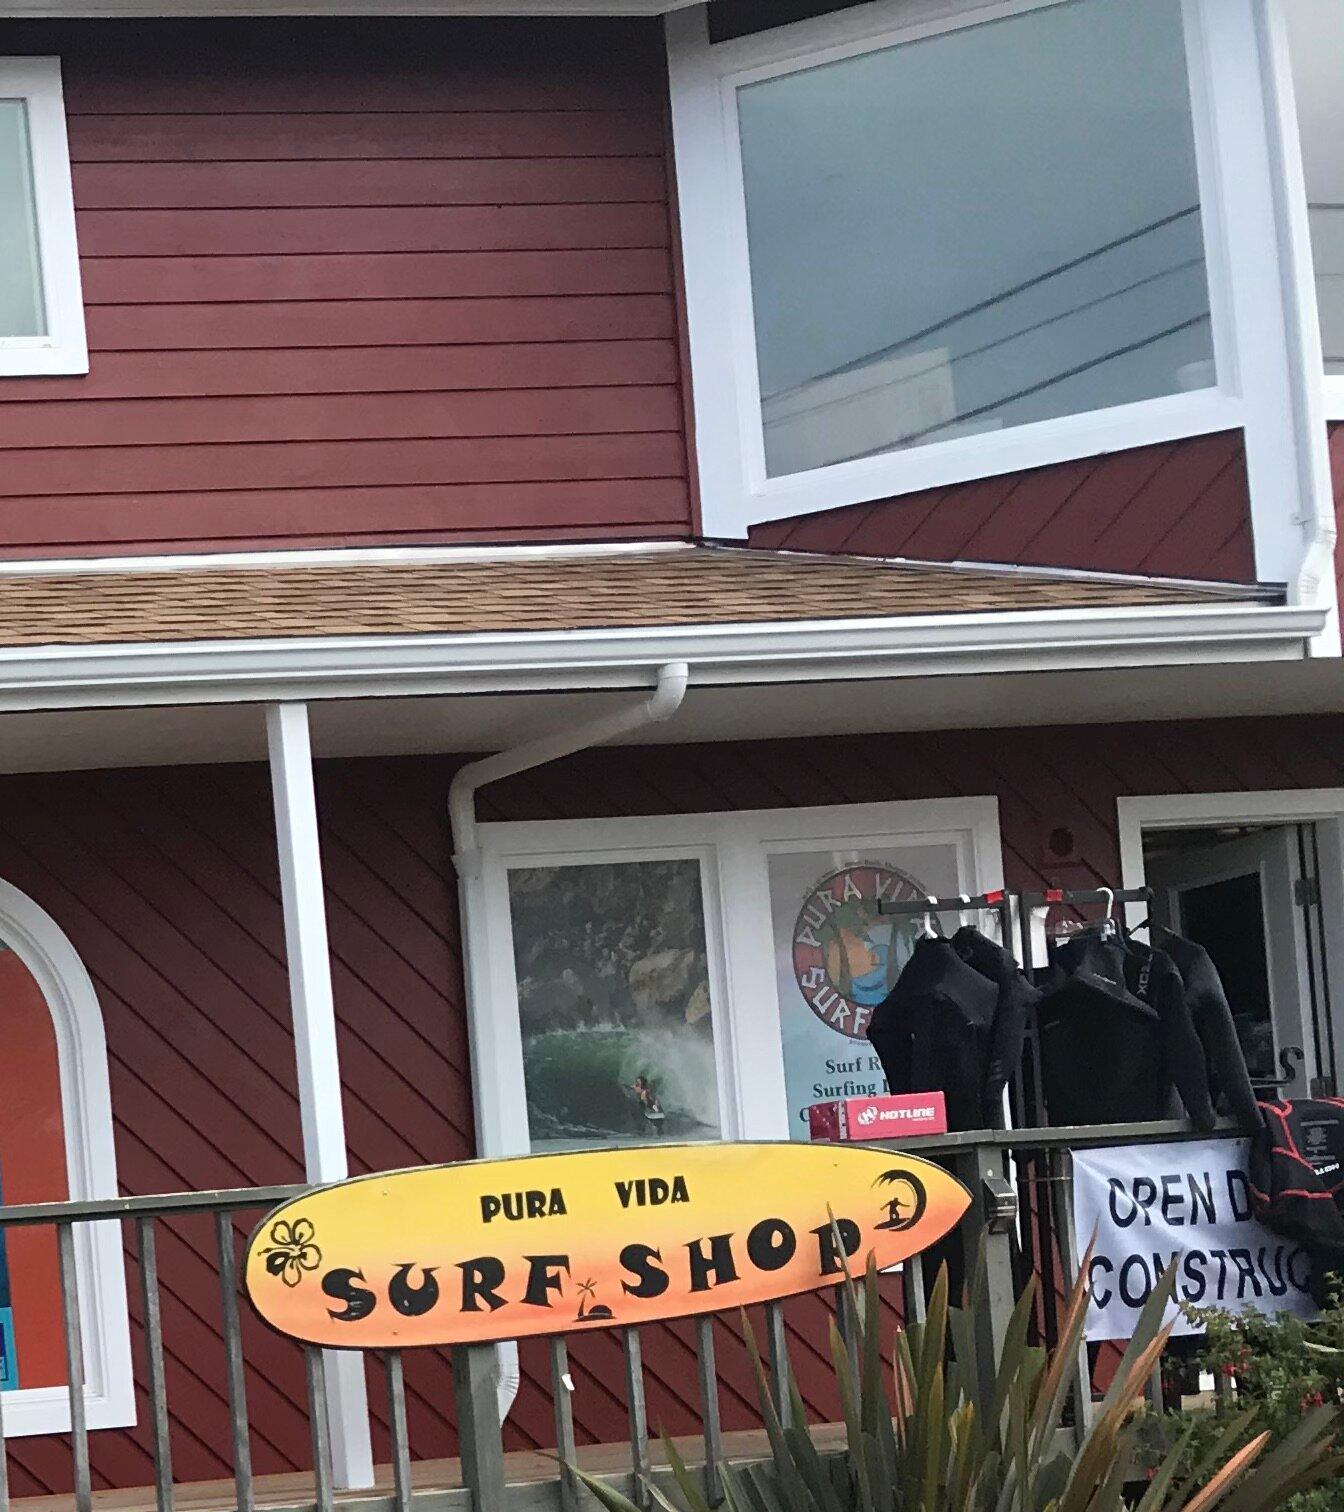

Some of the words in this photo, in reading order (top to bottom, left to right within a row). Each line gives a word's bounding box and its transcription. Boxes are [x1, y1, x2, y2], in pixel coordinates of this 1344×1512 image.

[801, 966, 870, 1034] SURF
[812, 1080, 877, 1099] Surfing
[825, 1057, 862, 1074] Surf
[480, 1187, 567, 1223] PURA
[614, 1175, 690, 1208] VIDA
[1108, 1171, 1216, 1228] OPEN
[321, 1254, 571, 1322] SURF
[619, 1217, 862, 1299] SHOP
[1089, 1247, 1311, 1310] CONSTRUC
